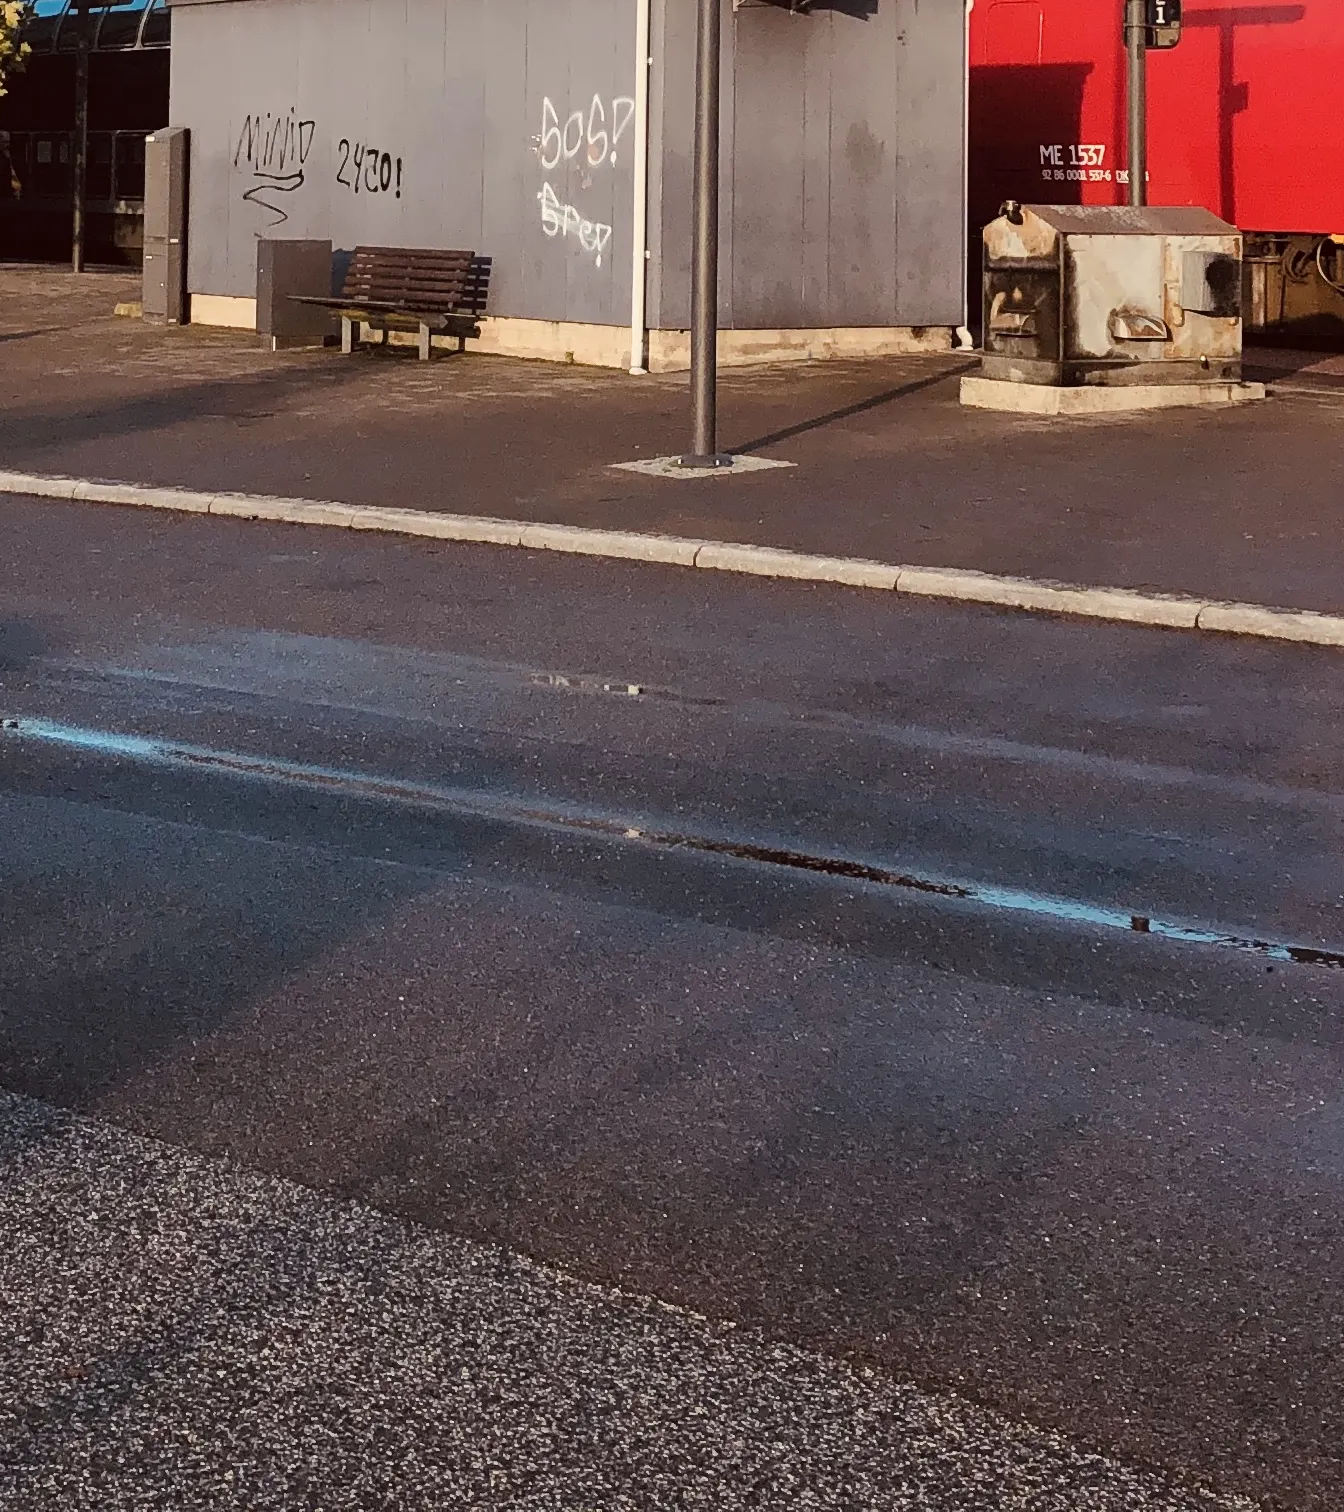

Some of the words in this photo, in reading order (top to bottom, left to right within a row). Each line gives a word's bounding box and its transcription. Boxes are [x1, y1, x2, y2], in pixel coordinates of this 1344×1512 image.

[1155, 6, 1166, 24] 1
[1039, 144, 1064, 166] ME
[1068, 144, 1106, 166] 1537
